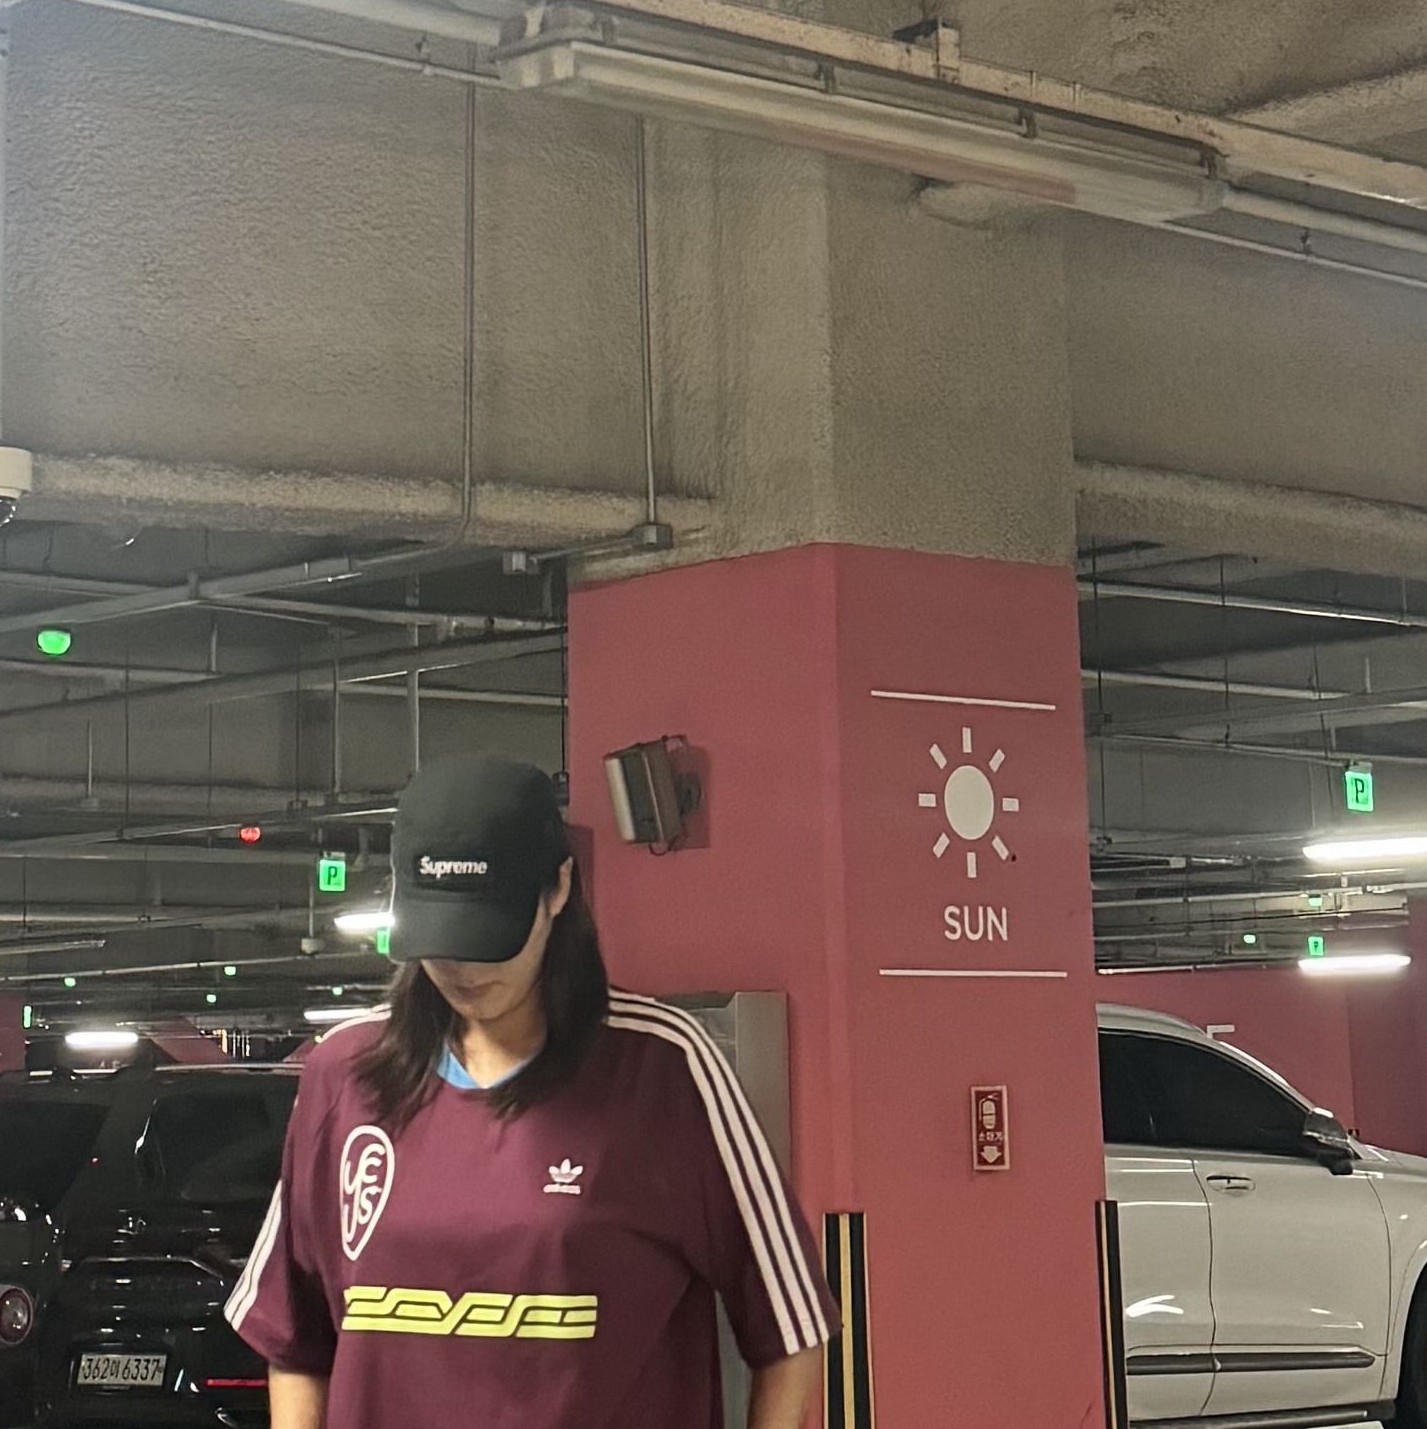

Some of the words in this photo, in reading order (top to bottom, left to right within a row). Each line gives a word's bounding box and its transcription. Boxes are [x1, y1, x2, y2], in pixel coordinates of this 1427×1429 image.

[1354, 777, 1365, 804] P
[419, 855, 488, 879] Supreme
[943, 905, 1009, 941] SUN
[121, 1358, 161, 1381] 6337
